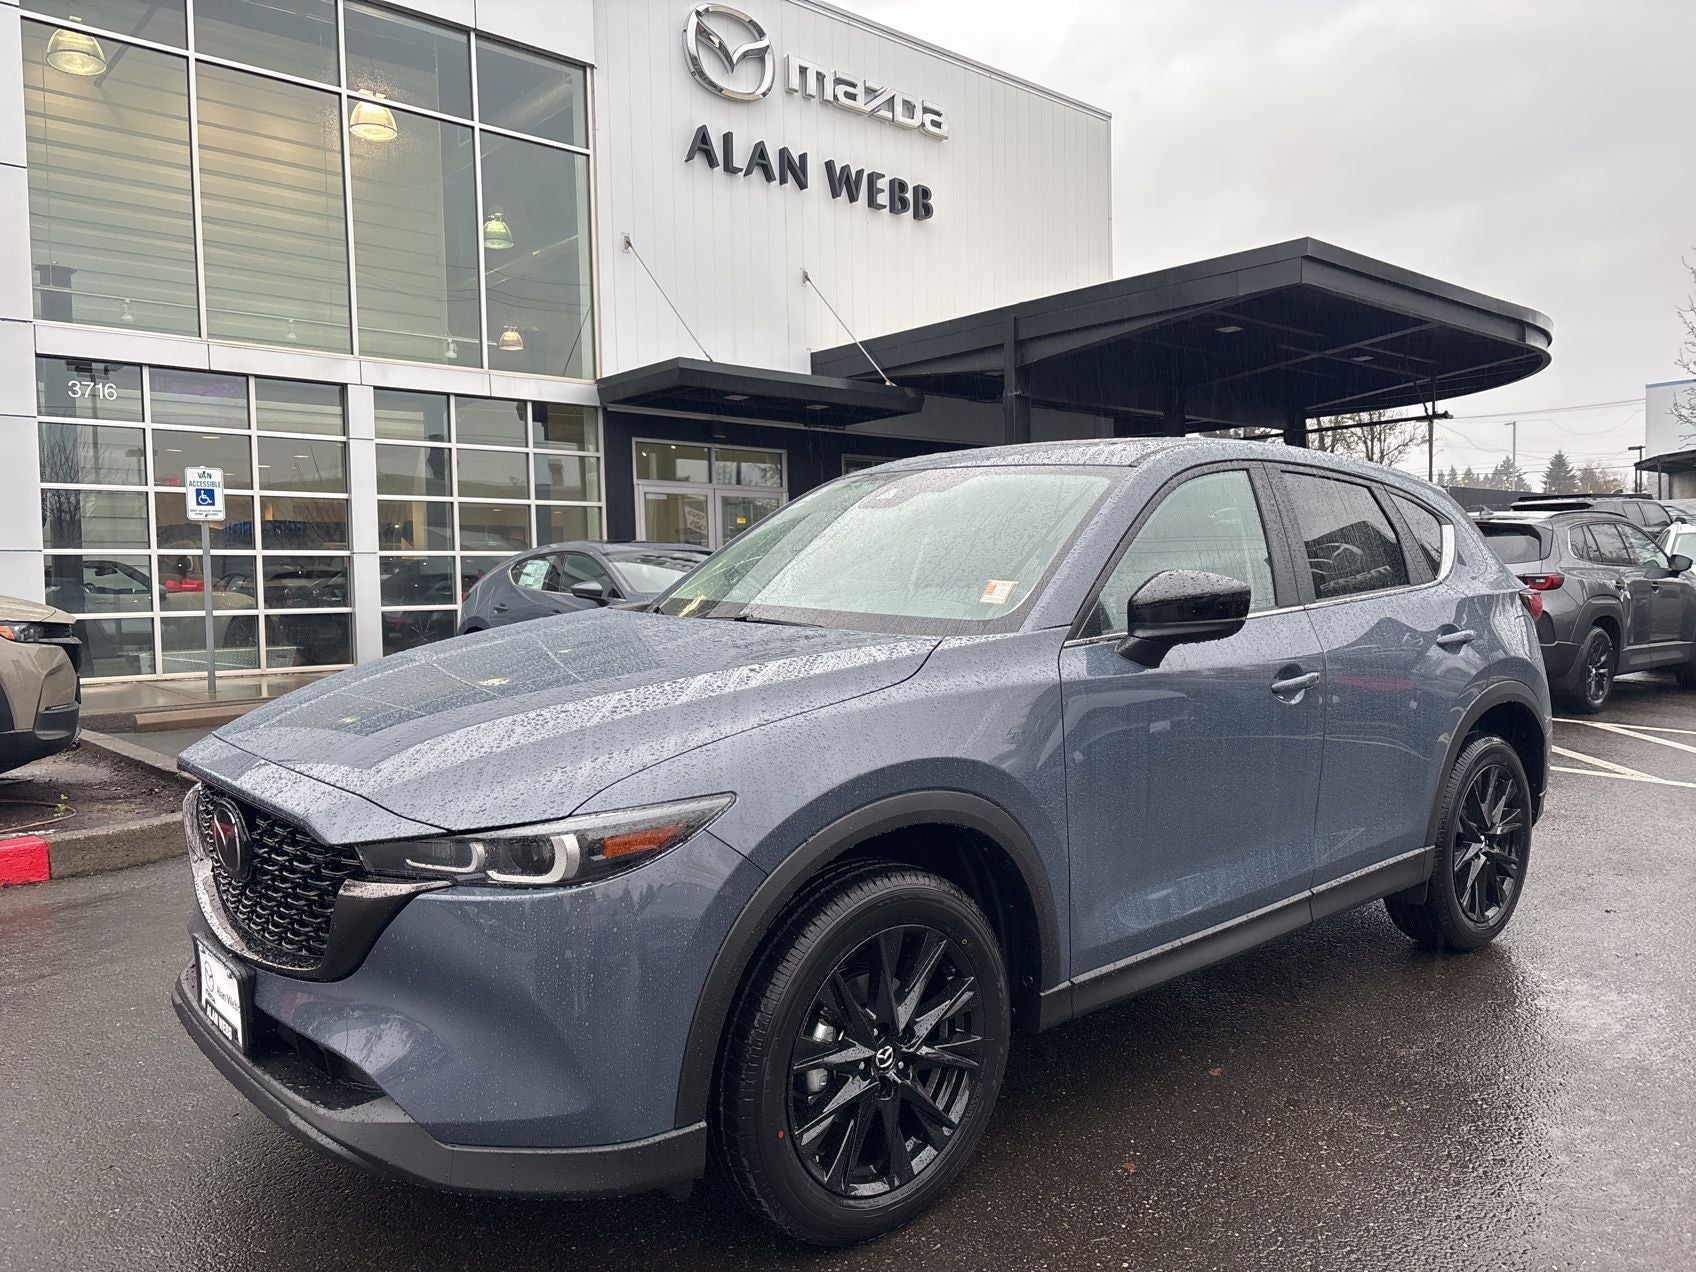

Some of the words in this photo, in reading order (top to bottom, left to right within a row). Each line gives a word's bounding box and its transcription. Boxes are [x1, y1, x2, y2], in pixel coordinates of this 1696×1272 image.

[684, 124, 808, 191] ALAN
[824, 159, 934, 221] WEBB
[68, 380, 118, 400] 3716
[197, 471, 212, 479] VAN
[189, 480, 222, 488] ACCESSIBLE
